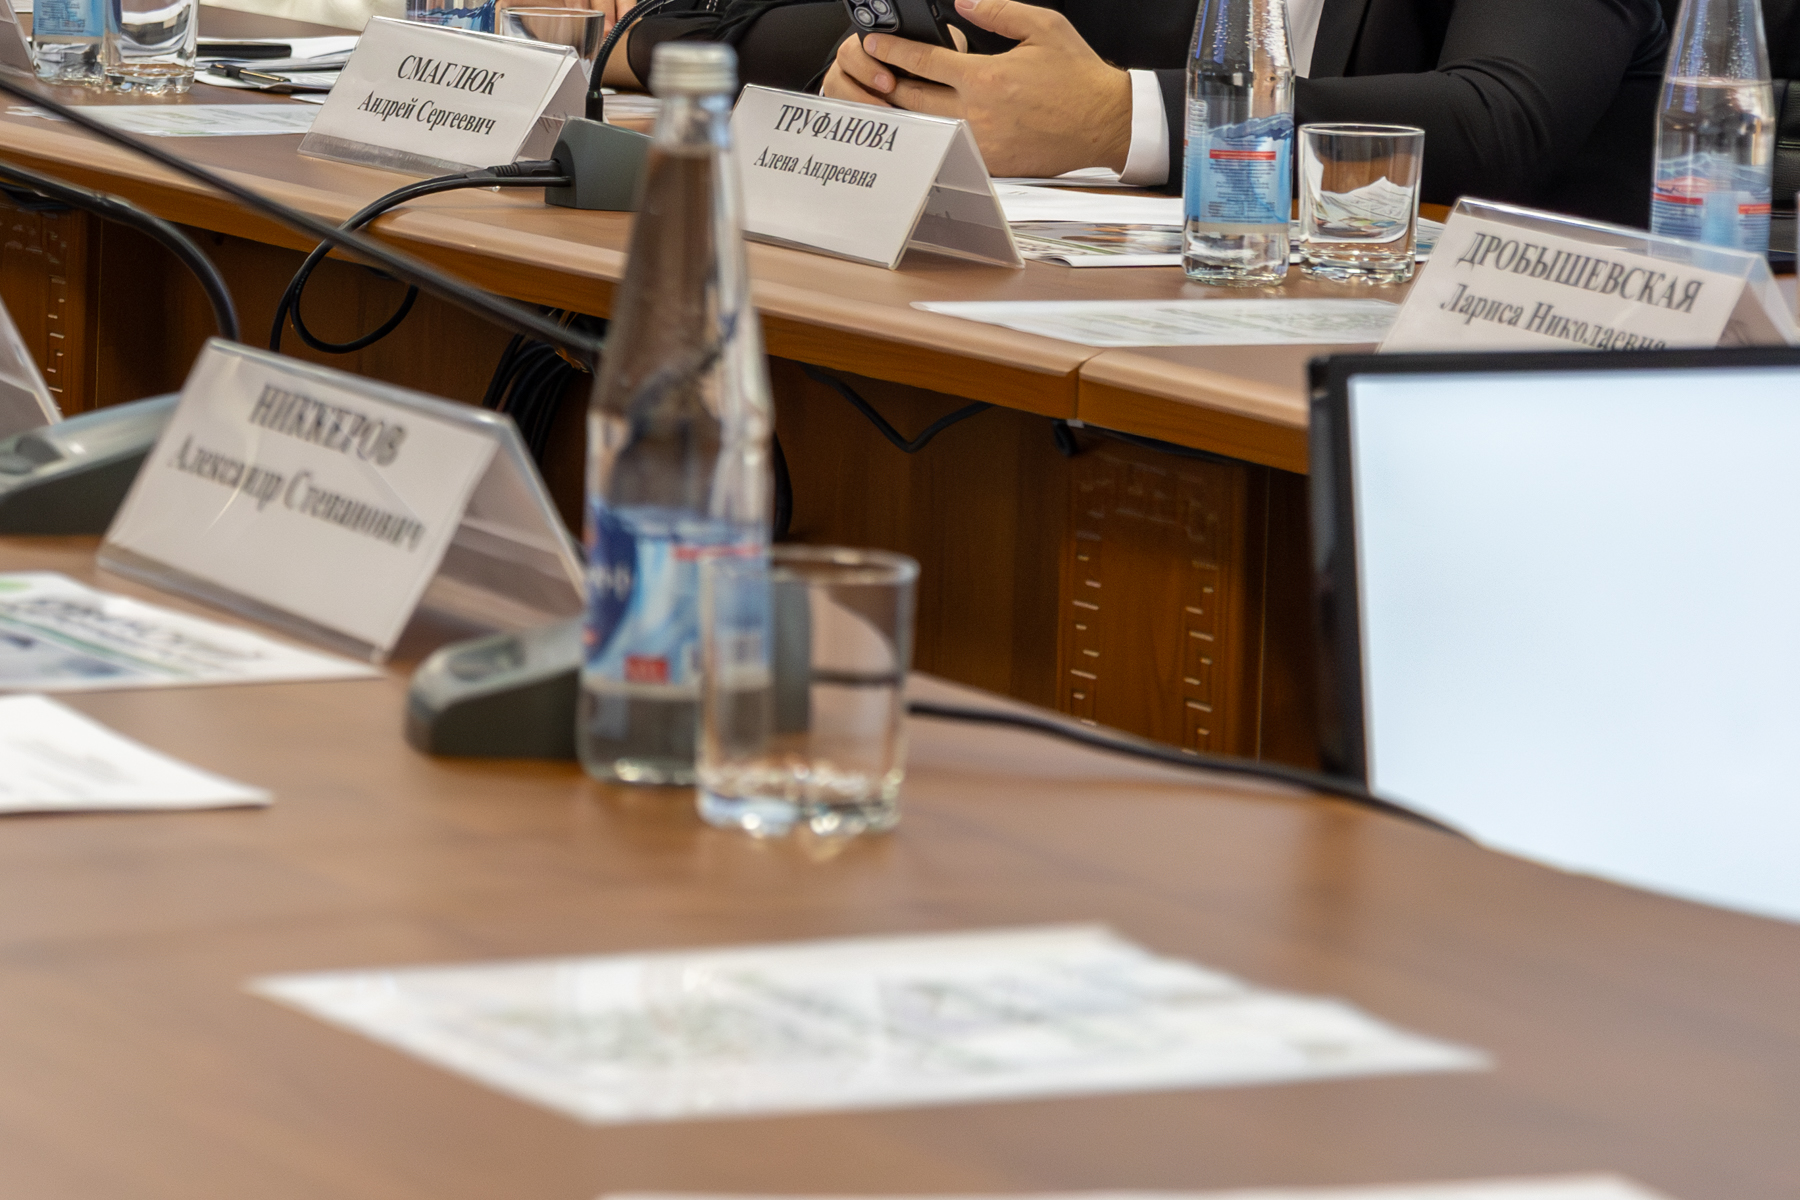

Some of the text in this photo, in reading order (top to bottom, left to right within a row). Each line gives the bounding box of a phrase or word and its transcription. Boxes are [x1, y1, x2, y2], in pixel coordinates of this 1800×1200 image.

[397, 54, 504, 96] СМАГЛЮК
[357, 90, 497, 135] Андрей Сергеевич
[774, 104, 900, 152] ТРУФАНОВА
[753, 146, 878, 188] Алена Андреевна
[1455, 231, 1705, 313] ДРОБЫШЕВСКАЯ
[1439, 283, 1668, 351] Лариса Николаевна
